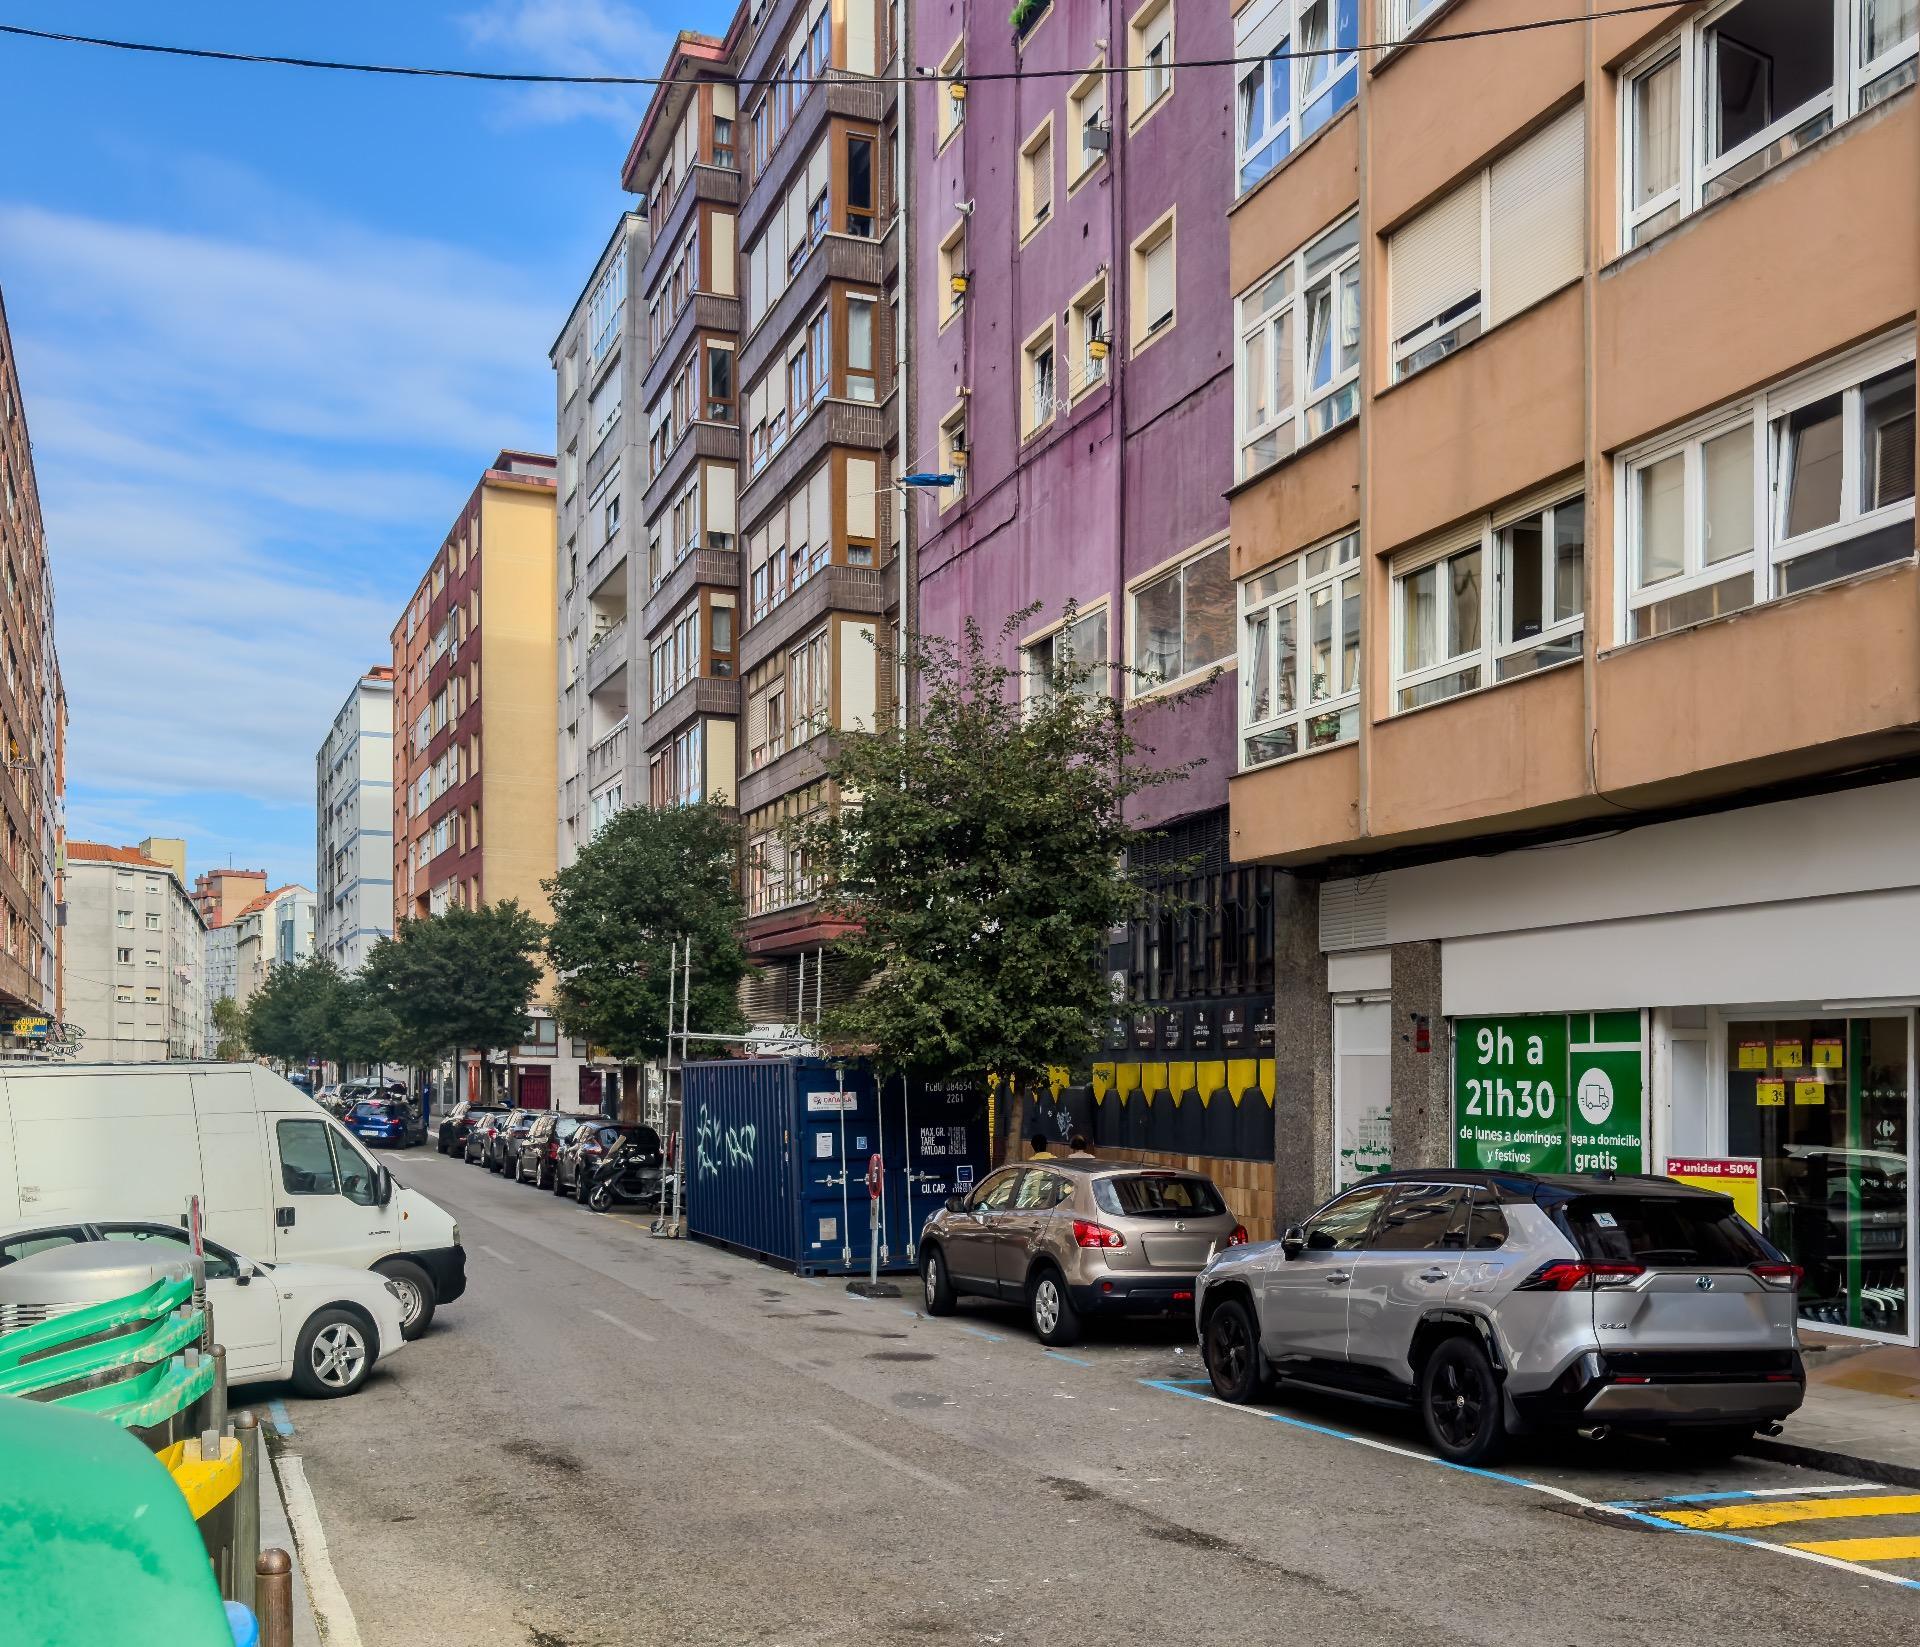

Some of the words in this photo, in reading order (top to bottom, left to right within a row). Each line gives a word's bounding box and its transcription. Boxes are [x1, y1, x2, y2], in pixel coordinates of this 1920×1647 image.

[1476, 1026, 1514, 1065] 9h
[1526, 1035, 1543, 1065] a
[1465, 1078, 1555, 1119] 21h30
[920, 1136, 936, 1146] TARE
[1459, 1125, 1473, 1139] de
[1475, 1126, 1502, 1141] lunes
[1504, 1130, 1511, 1140] a
[1513, 1128, 1562, 1147] domingos
[1589, 1135, 1596, 1145] a
[1597, 1134, 1641, 1147] domicilio
[920, 1145, 946, 1155] PAYLOAD
[1487, 1151, 1493, 1163] y
[1494, 1149, 1531, 1163] festivos
[1574, 1151, 1618, 1173] gratis
[1683, 1163, 1721, 1173] unidad
[1724, 1164, 1755, 1175] -50%
